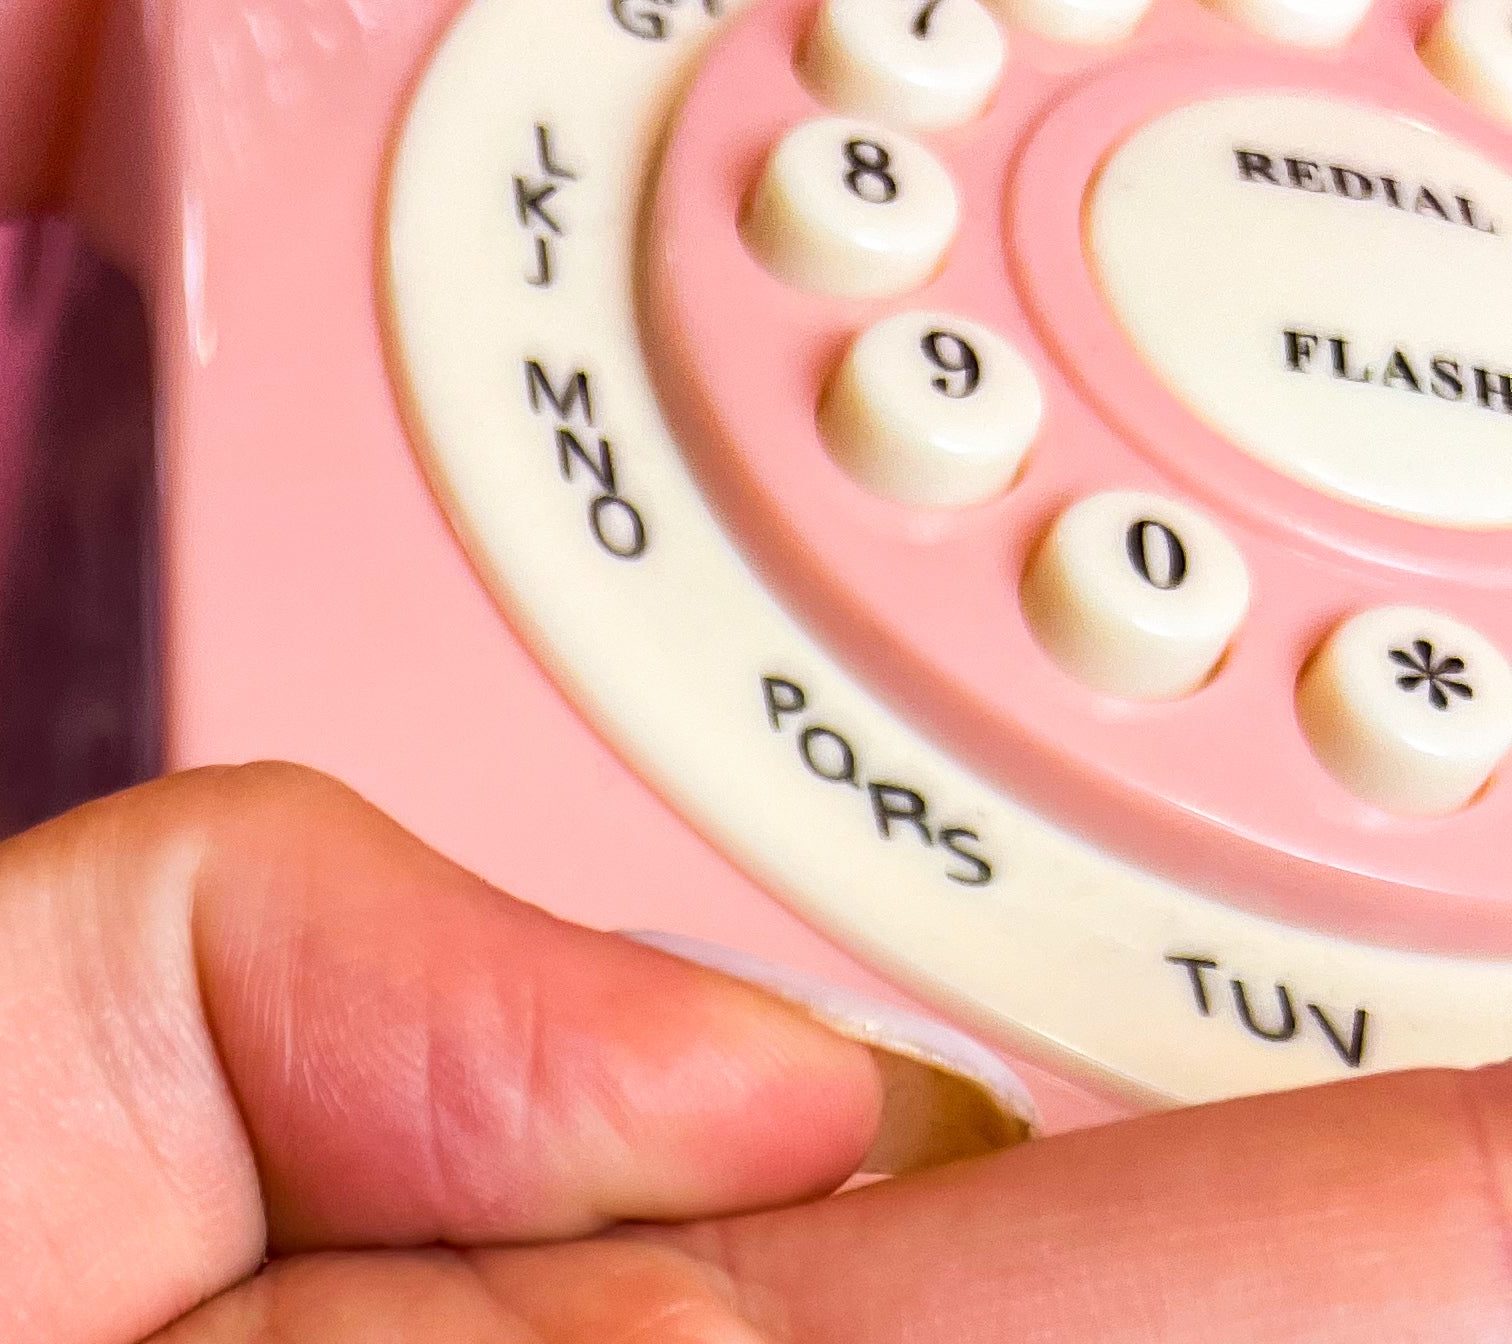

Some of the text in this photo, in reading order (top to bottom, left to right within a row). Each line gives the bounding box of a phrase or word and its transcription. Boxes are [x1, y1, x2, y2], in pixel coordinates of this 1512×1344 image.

[842, 136, 899, 204] 8
[1233, 149, 1498, 235] REDIAL
[919, 328, 982, 399] 9
[1283, 329, 1512, 416] FLASH
[523, 358, 647, 560] MNO
[762, 676, 992, 888] PQRS
[1164, 955, 1368, 1068] TUV
